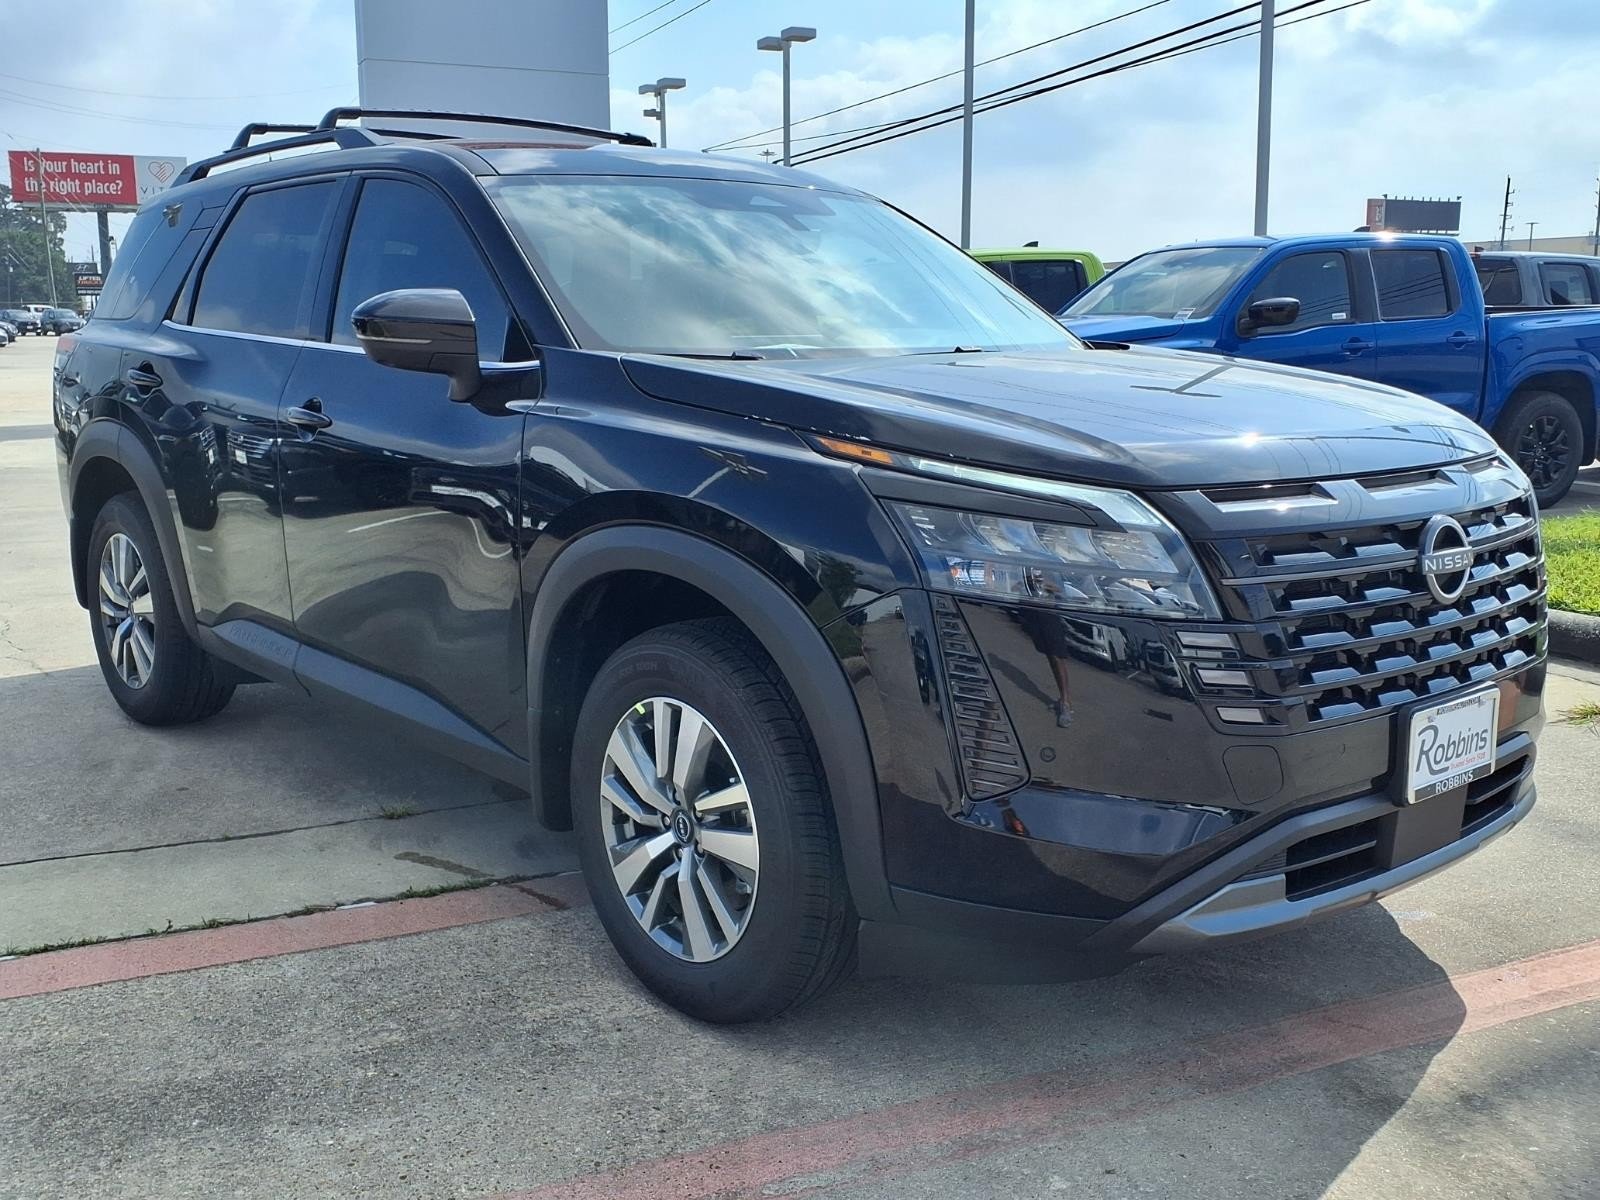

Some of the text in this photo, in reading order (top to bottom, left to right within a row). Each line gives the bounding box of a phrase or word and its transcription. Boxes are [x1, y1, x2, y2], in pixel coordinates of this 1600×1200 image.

[24, 157, 120, 175] Is your heart in
[25, 177, 122, 196] the right place?
[1415, 724, 1488, 776] Robbins
[1435, 770, 1474, 794] ROBBINS
